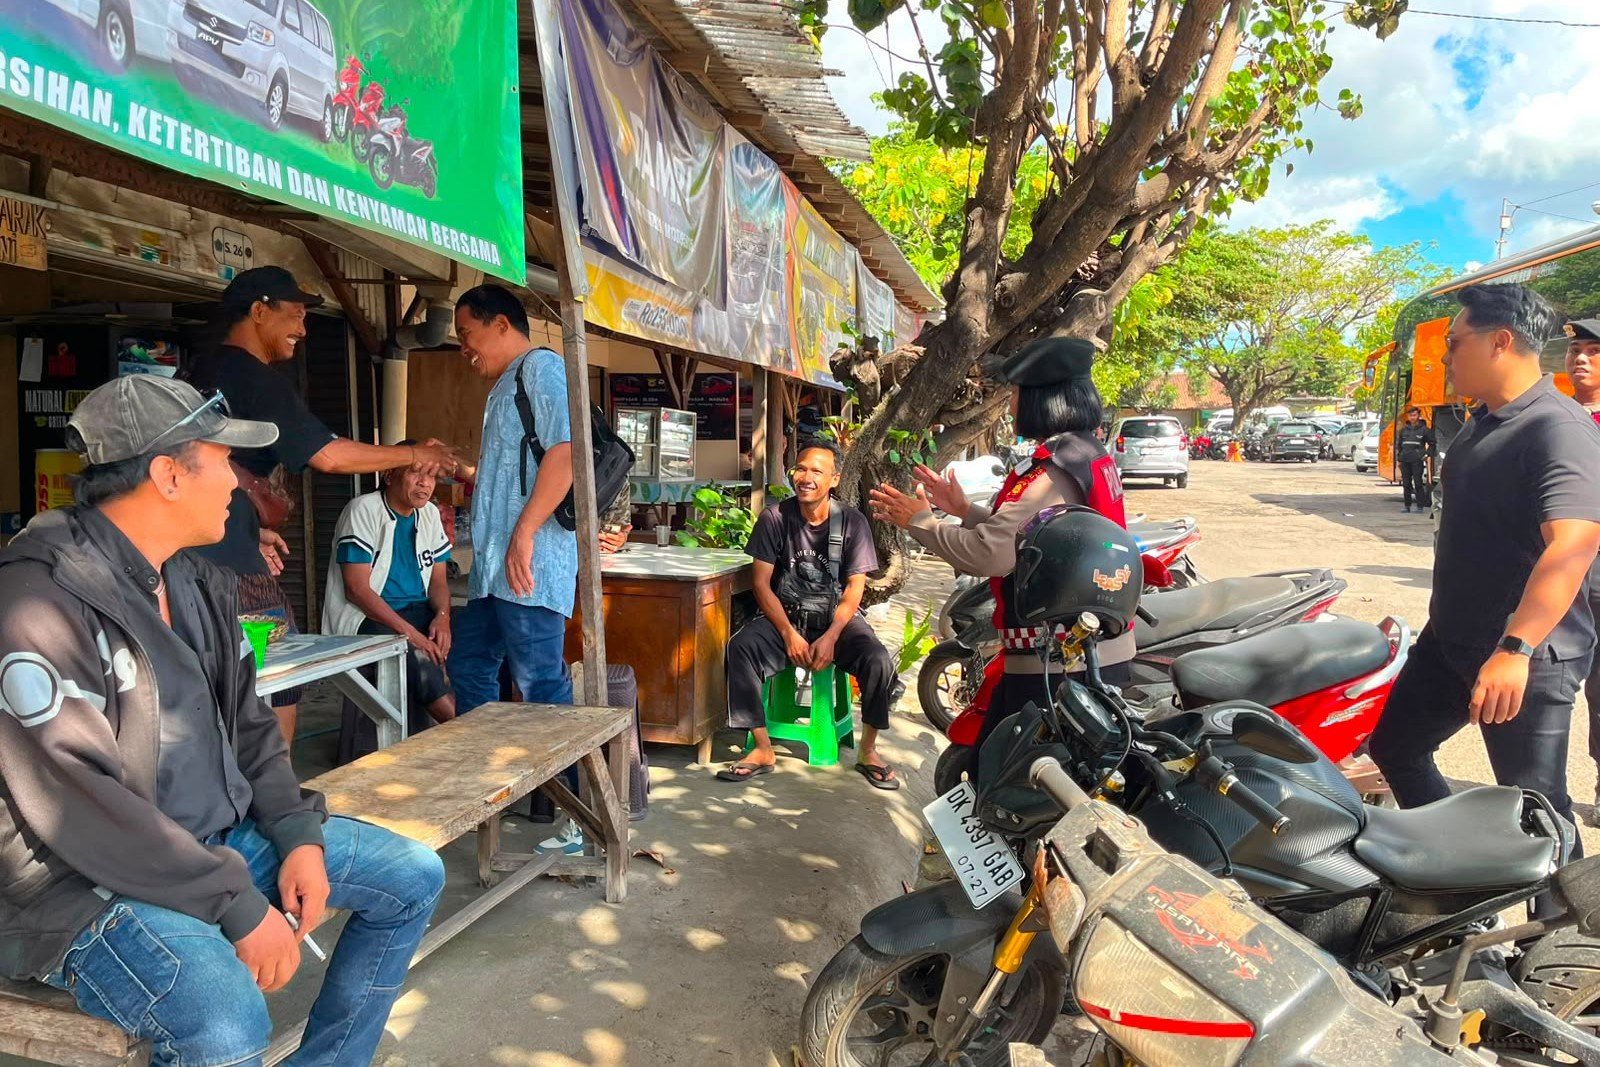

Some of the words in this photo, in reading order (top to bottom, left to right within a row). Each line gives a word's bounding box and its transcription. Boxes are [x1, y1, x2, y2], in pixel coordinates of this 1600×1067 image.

[0, 51, 119, 133] SIHAN,
[128, 101, 282, 190] KETERTIBAN
[286, 165, 331, 206] DAN
[333, 184, 428, 241] KENYAMAN
[430, 221, 501, 266] BERSAMA
[24, 389, 64, 413] NATURAL
[947, 788, 972, 813] DK
[960, 814, 995, 850] 4397
[983, 851, 1014, 887] GAB
